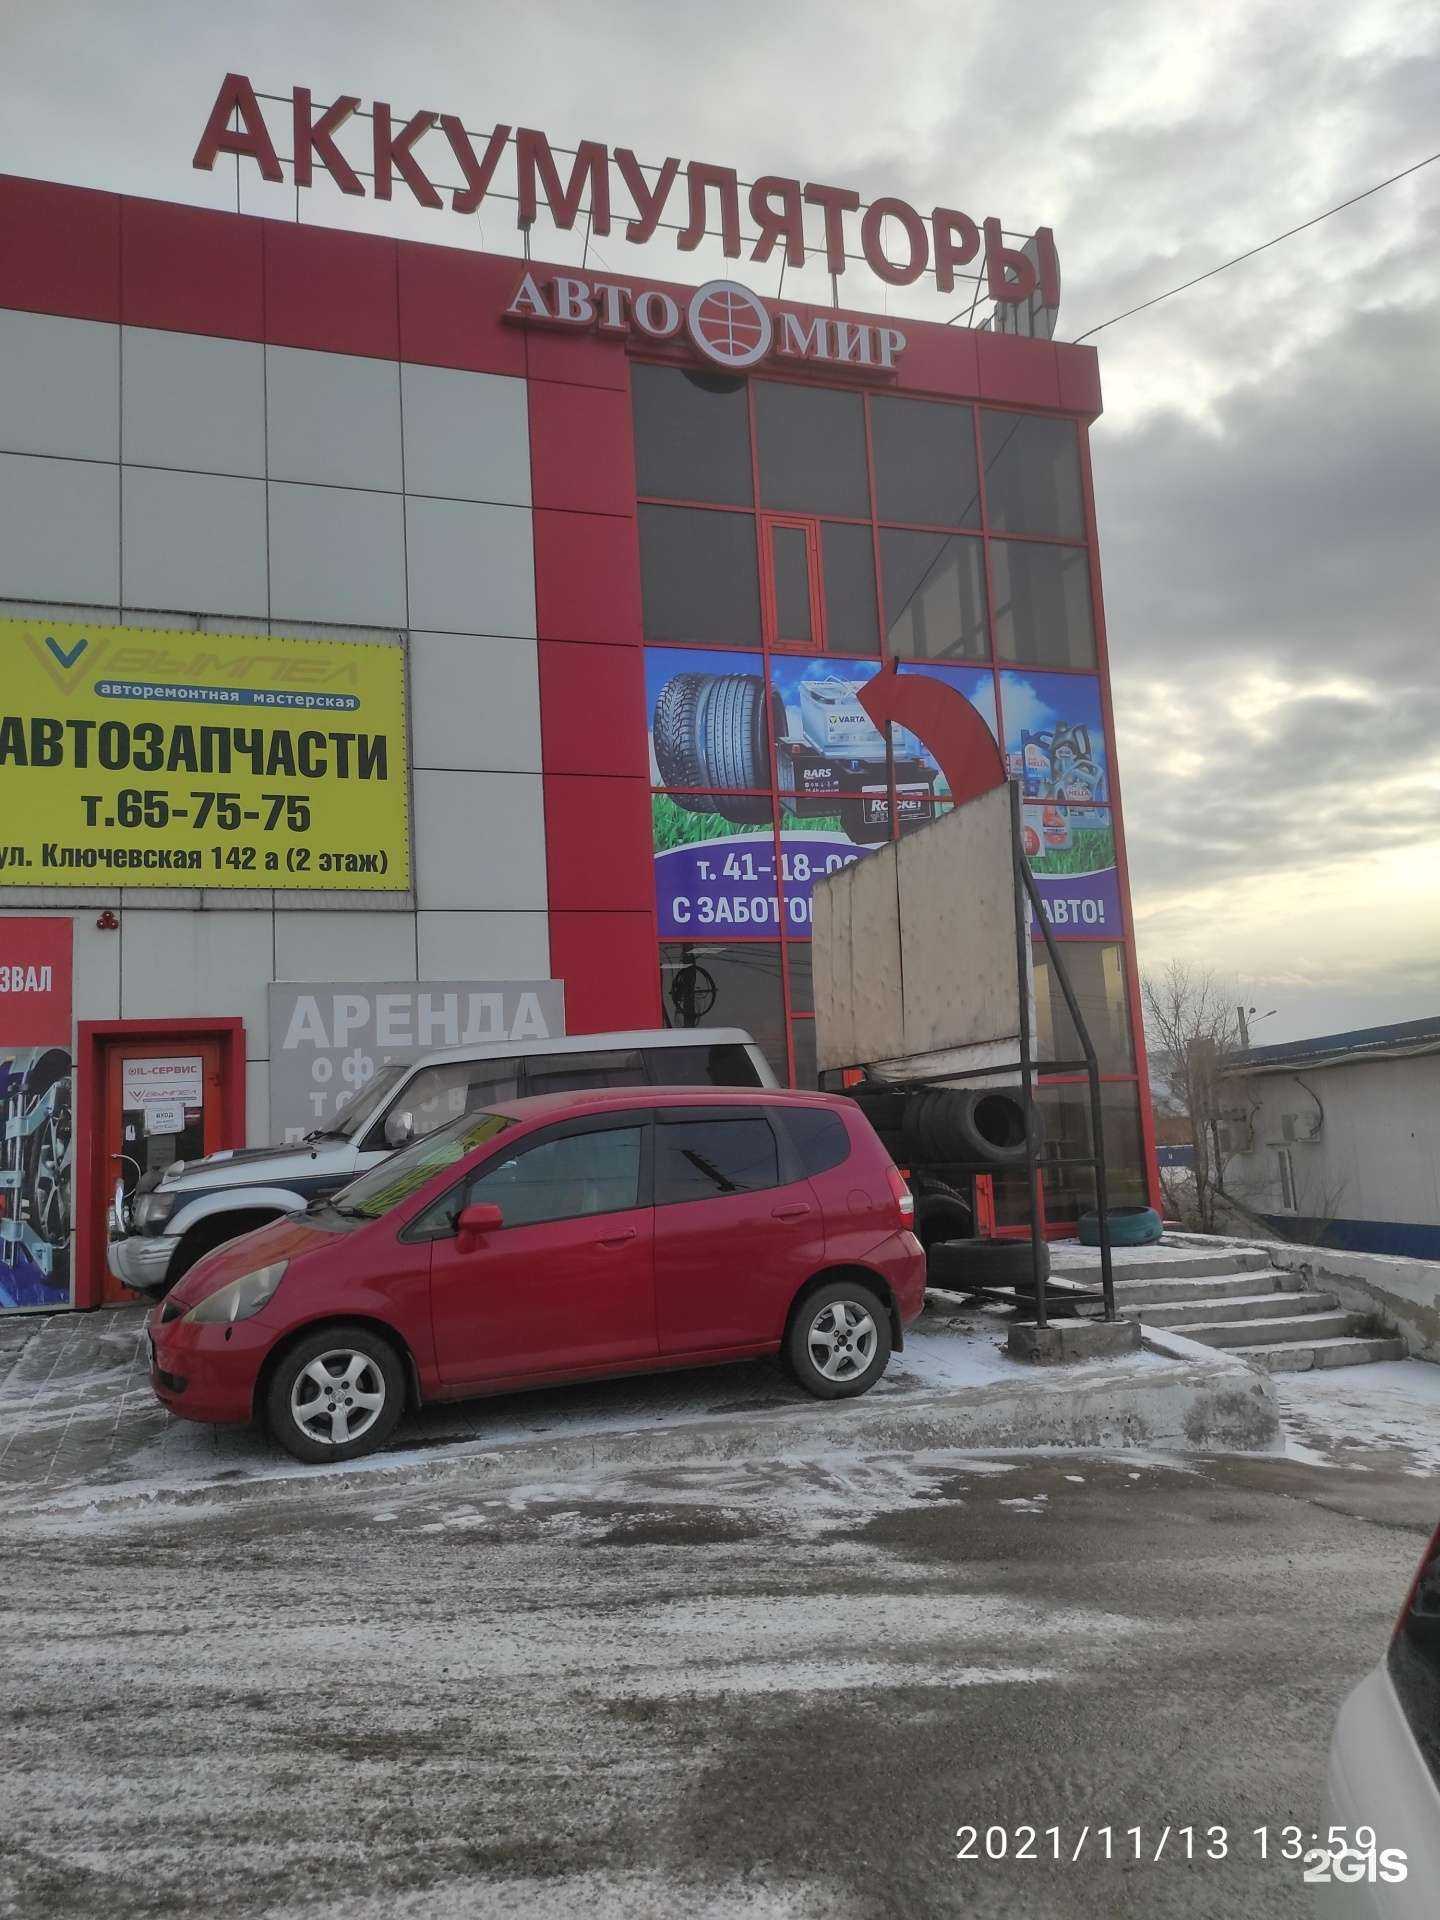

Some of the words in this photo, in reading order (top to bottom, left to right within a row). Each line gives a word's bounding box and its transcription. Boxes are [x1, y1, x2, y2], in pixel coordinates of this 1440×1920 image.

[193, 72, 1060, 307] АККУМУЛЯТОРЫ
[506, 271, 681, 335] АВТО
[779, 312, 907, 369] МИР
[104, 646, 361, 686] ВЫМПЕЛ
[100, 682, 240, 703] авторемонтная
[253, 692, 356, 710] мастерская
[838, 715, 865, 723] VARTA
[0, 716, 388, 781] АВТОЗАПЧАСТИ
[803, 768, 832, 779] BARS
[80, 788, 311, 832] т.65-75-75
[0, 846, 33, 869] ул.
[42, 843, 202, 869] Ключевская
[211, 846, 257, 870] 142
[265, 851, 279, 871] а
[286, 847, 311, 872] (2
[318, 849, 388, 874] этаж)
[672, 896, 691, 923] С
[697, 896, 813, 923] ЗАБОТО
[0, 966, 52, 992] ЗВАЛ
[283, 992, 550, 1049] АРЕНДА
